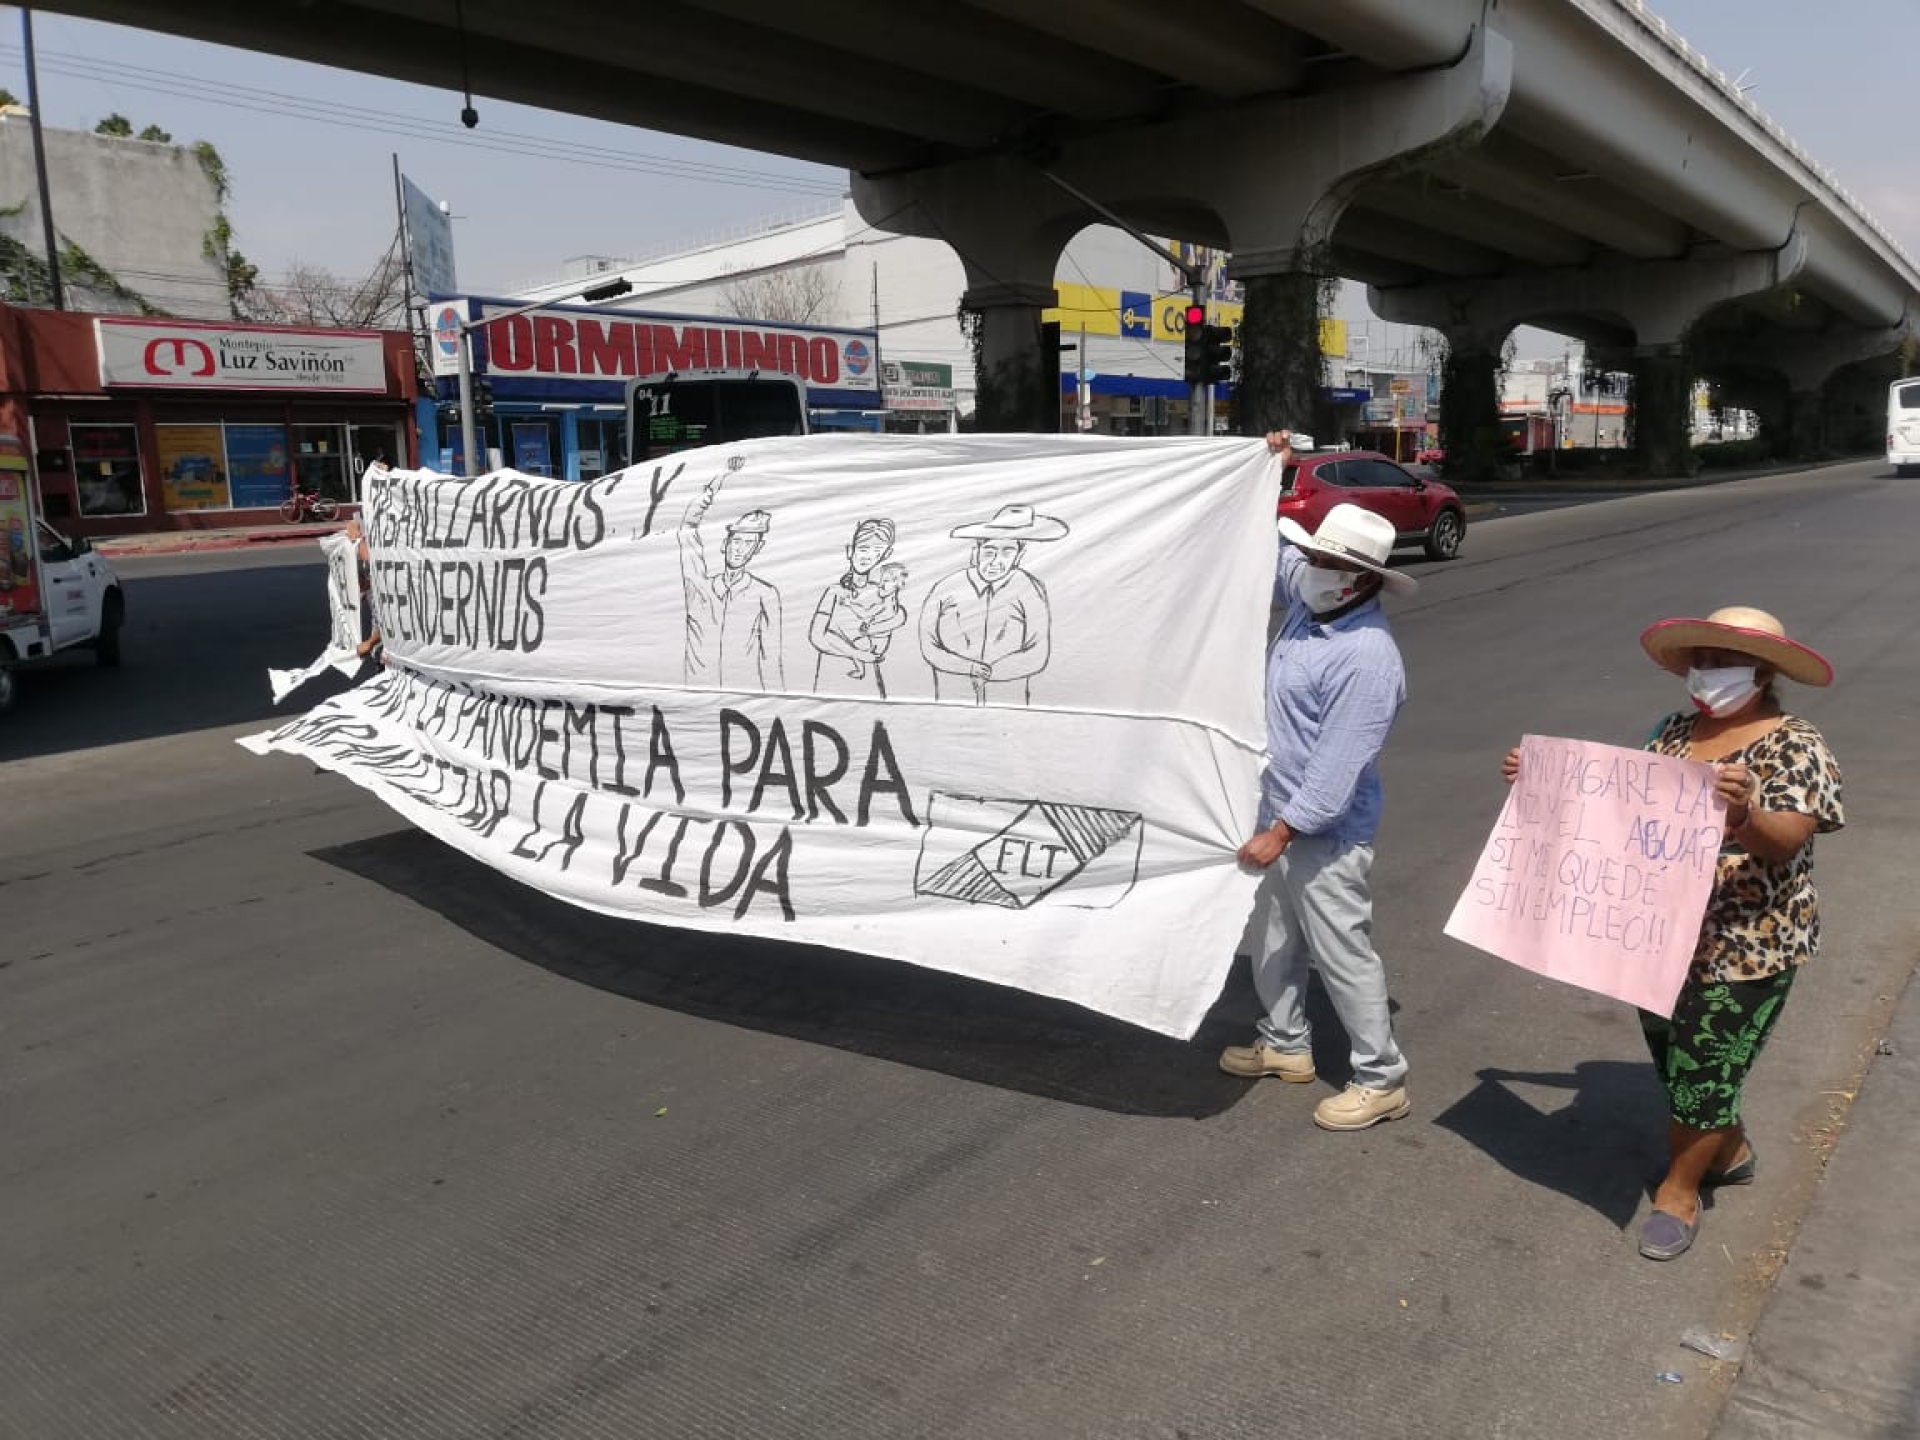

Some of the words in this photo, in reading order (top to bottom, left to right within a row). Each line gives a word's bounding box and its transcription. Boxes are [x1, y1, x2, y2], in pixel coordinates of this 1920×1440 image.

[219, 350, 258, 371] Luz
[265, 351, 345, 373] Saviñón
[485, 313, 839, 384] ORMIMUNDO
[639, 463, 686, 540] Y
[448, 681, 685, 805] PANDEMIA
[720, 708, 920, 827] PARA
[1675, 773, 1709, 821] LA
[510, 780, 588, 871] LA
[612, 802, 796, 922] VIDA
[1491, 837, 1522, 871] SI
[1475, 878, 1528, 920] SIN
